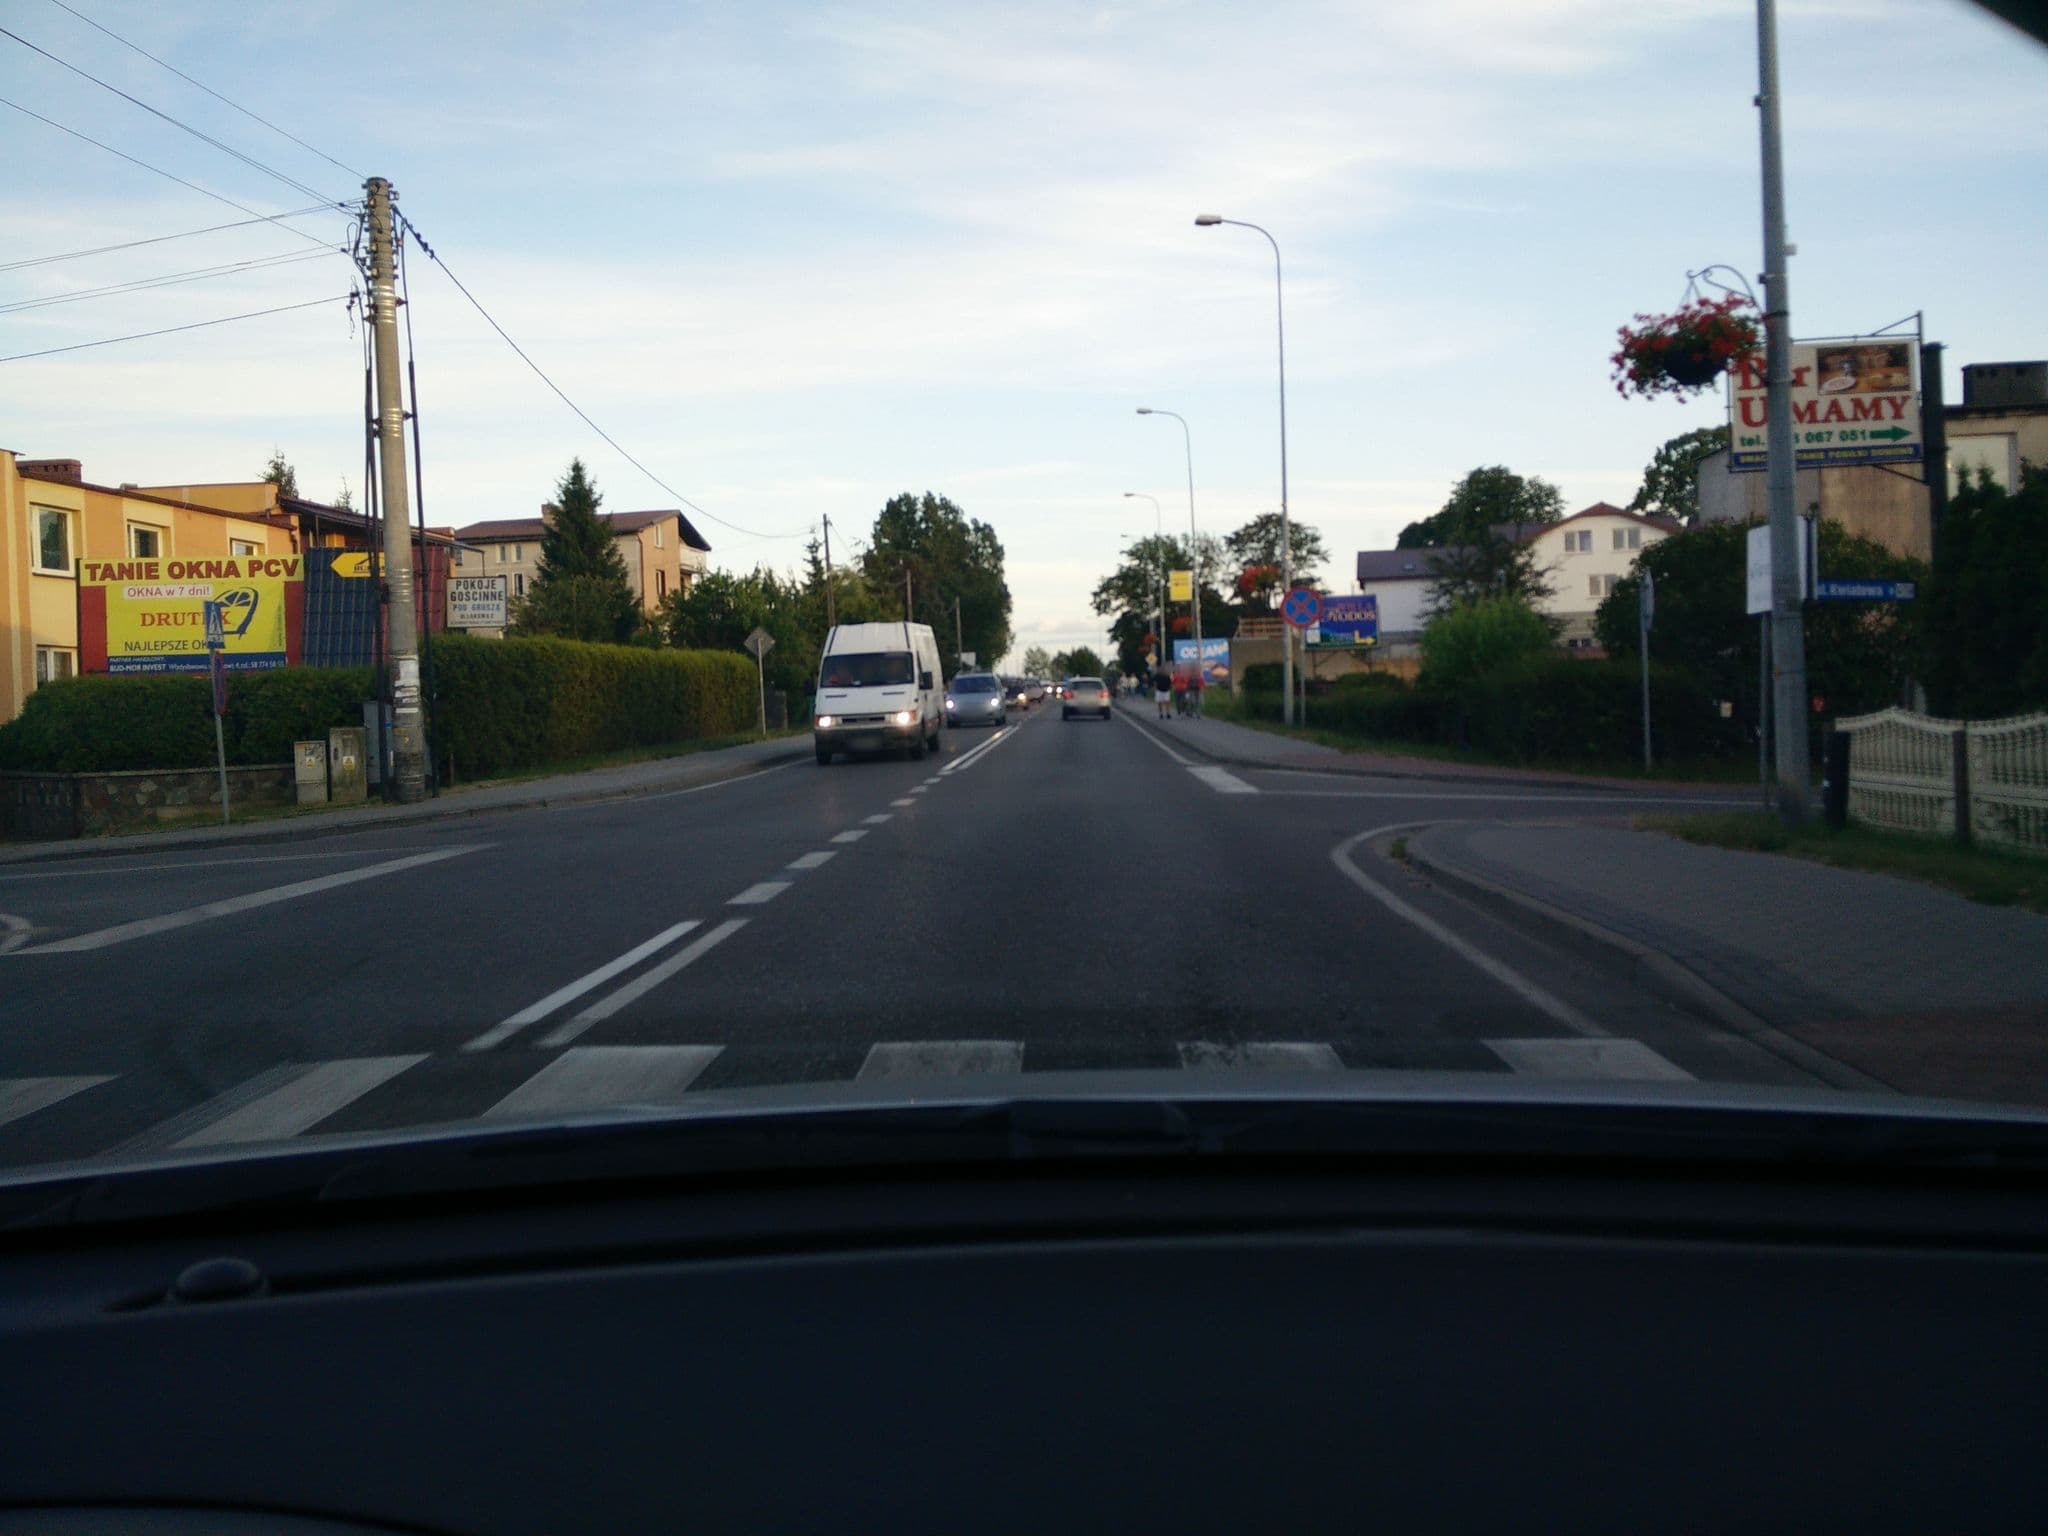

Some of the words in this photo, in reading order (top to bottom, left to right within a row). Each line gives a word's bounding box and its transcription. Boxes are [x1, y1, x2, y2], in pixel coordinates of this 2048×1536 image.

[1737, 357, 1811, 390] Br
[1792, 395, 1912, 425] MAMY
[84, 561, 160, 581] TANIE
[167, 560, 241, 580] OKNA
[247, 558, 300, 578] PCV
[455, 579, 496, 590] POKOJE
[127, 586, 163, 598] OKNA
[165, 588, 175, 596] w
[178, 586, 184, 596] 7
[450, 591, 504, 601] GOŚCINNE
[140, 611, 232, 628] DRUTX
[124, 640, 189, 652] NAJLEPSZE
